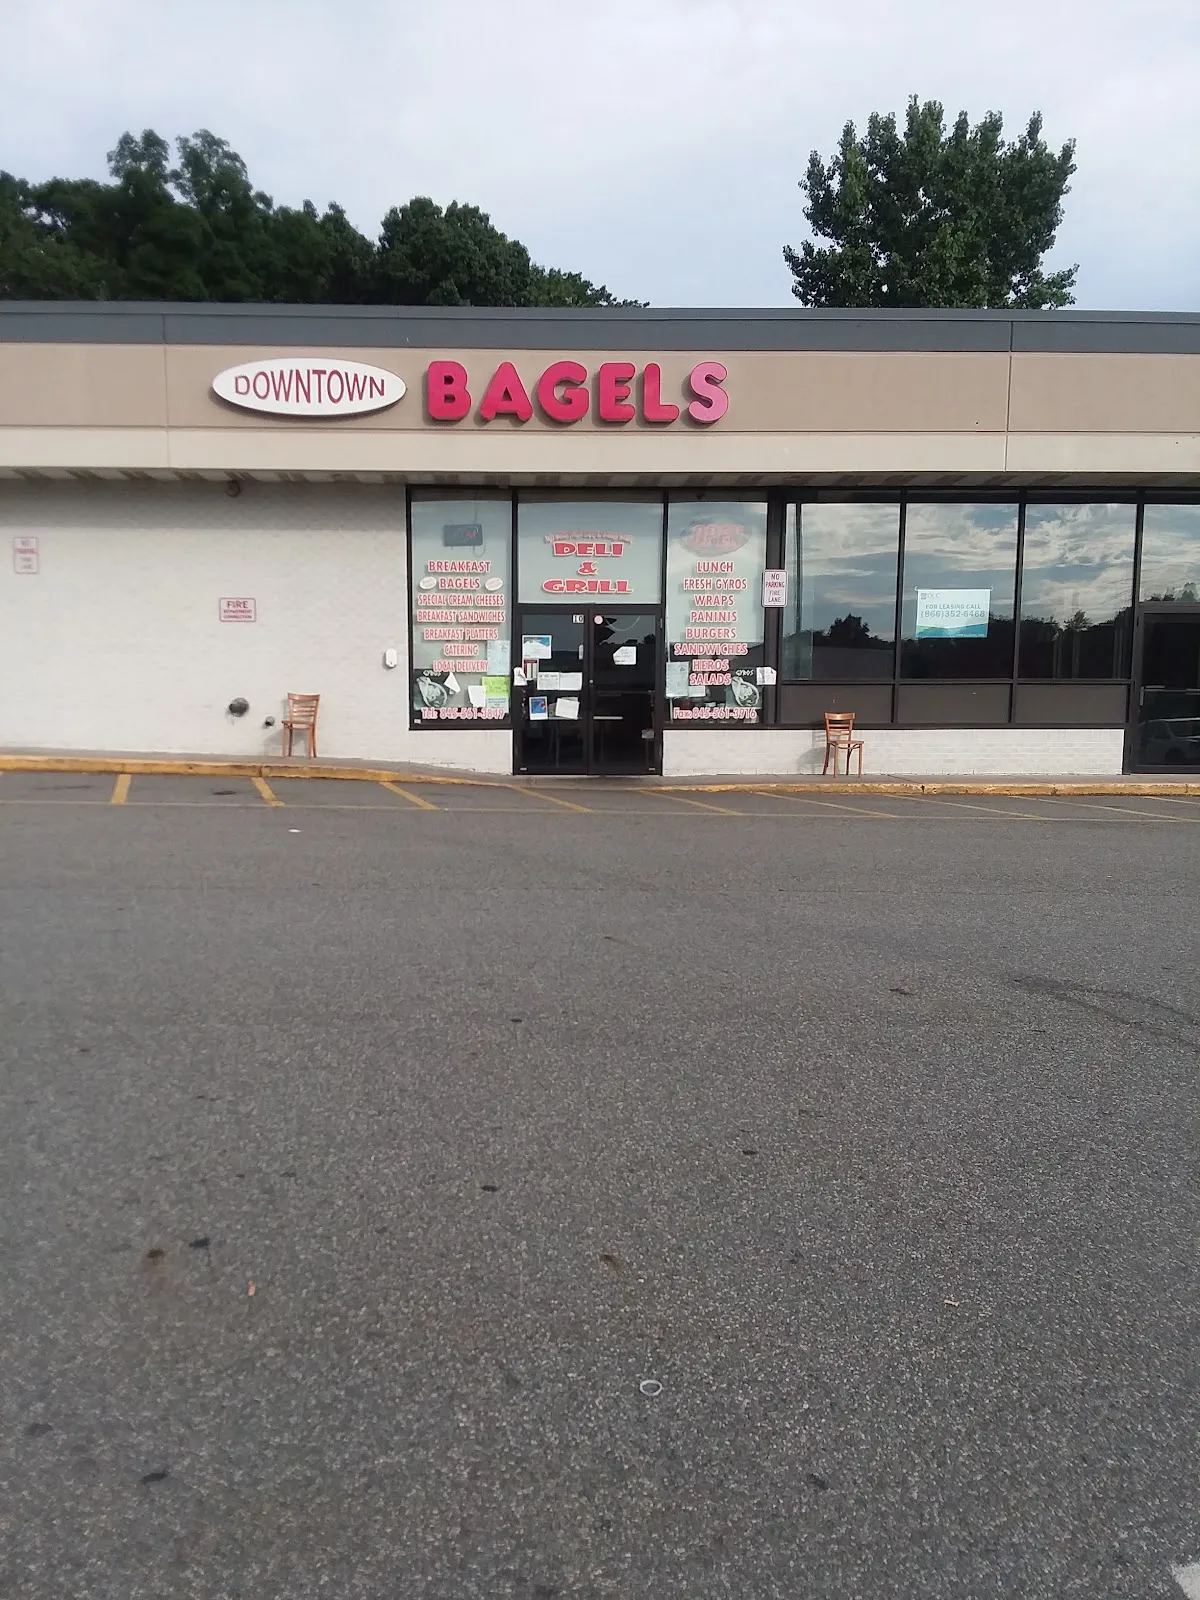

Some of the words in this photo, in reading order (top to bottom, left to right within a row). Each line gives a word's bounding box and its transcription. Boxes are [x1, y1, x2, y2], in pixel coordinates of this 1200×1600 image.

[235, 369, 385, 404] DOWNTOWN
[428, 360, 729, 423] BAGELS
[553, 542, 624, 556] DELI
[428, 561, 491, 572] BREAKFAST
[578, 561, 598, 575] &
[697, 561, 734, 573] LUNCH
[771, 573, 780, 581] NO
[439, 577, 481, 590] BAGELS
[543, 579, 634, 593] GRILL
[684, 578, 712, 590] FRESH
[715, 578, 747, 590] GYROS
[227, 600, 249, 609] FIRE
[418, 594, 446, 605] SPECIAL
[448, 594, 473, 605] CREAM
[475, 594, 504, 606] CHEESES
[694, 595, 734, 606] WRAPS
[417, 610, 456, 622] BREAKFAST
[458, 610, 505, 622] SANDWICHES
[690, 611, 737, 622] PANINIS
[424, 628, 464, 639] BREAKFAST
[465, 628, 498, 640] PLATTERS
[686, 627, 737, 639] BURGERS
[444, 644, 479, 656] CATERING
[674, 643, 748, 655] SANDWICHES
[433, 660, 455, 672] LOCAL
[456, 660, 488, 672] DELIVERY
[692, 659, 729, 671] HEROS
[690, 673, 731, 685] SALADS
